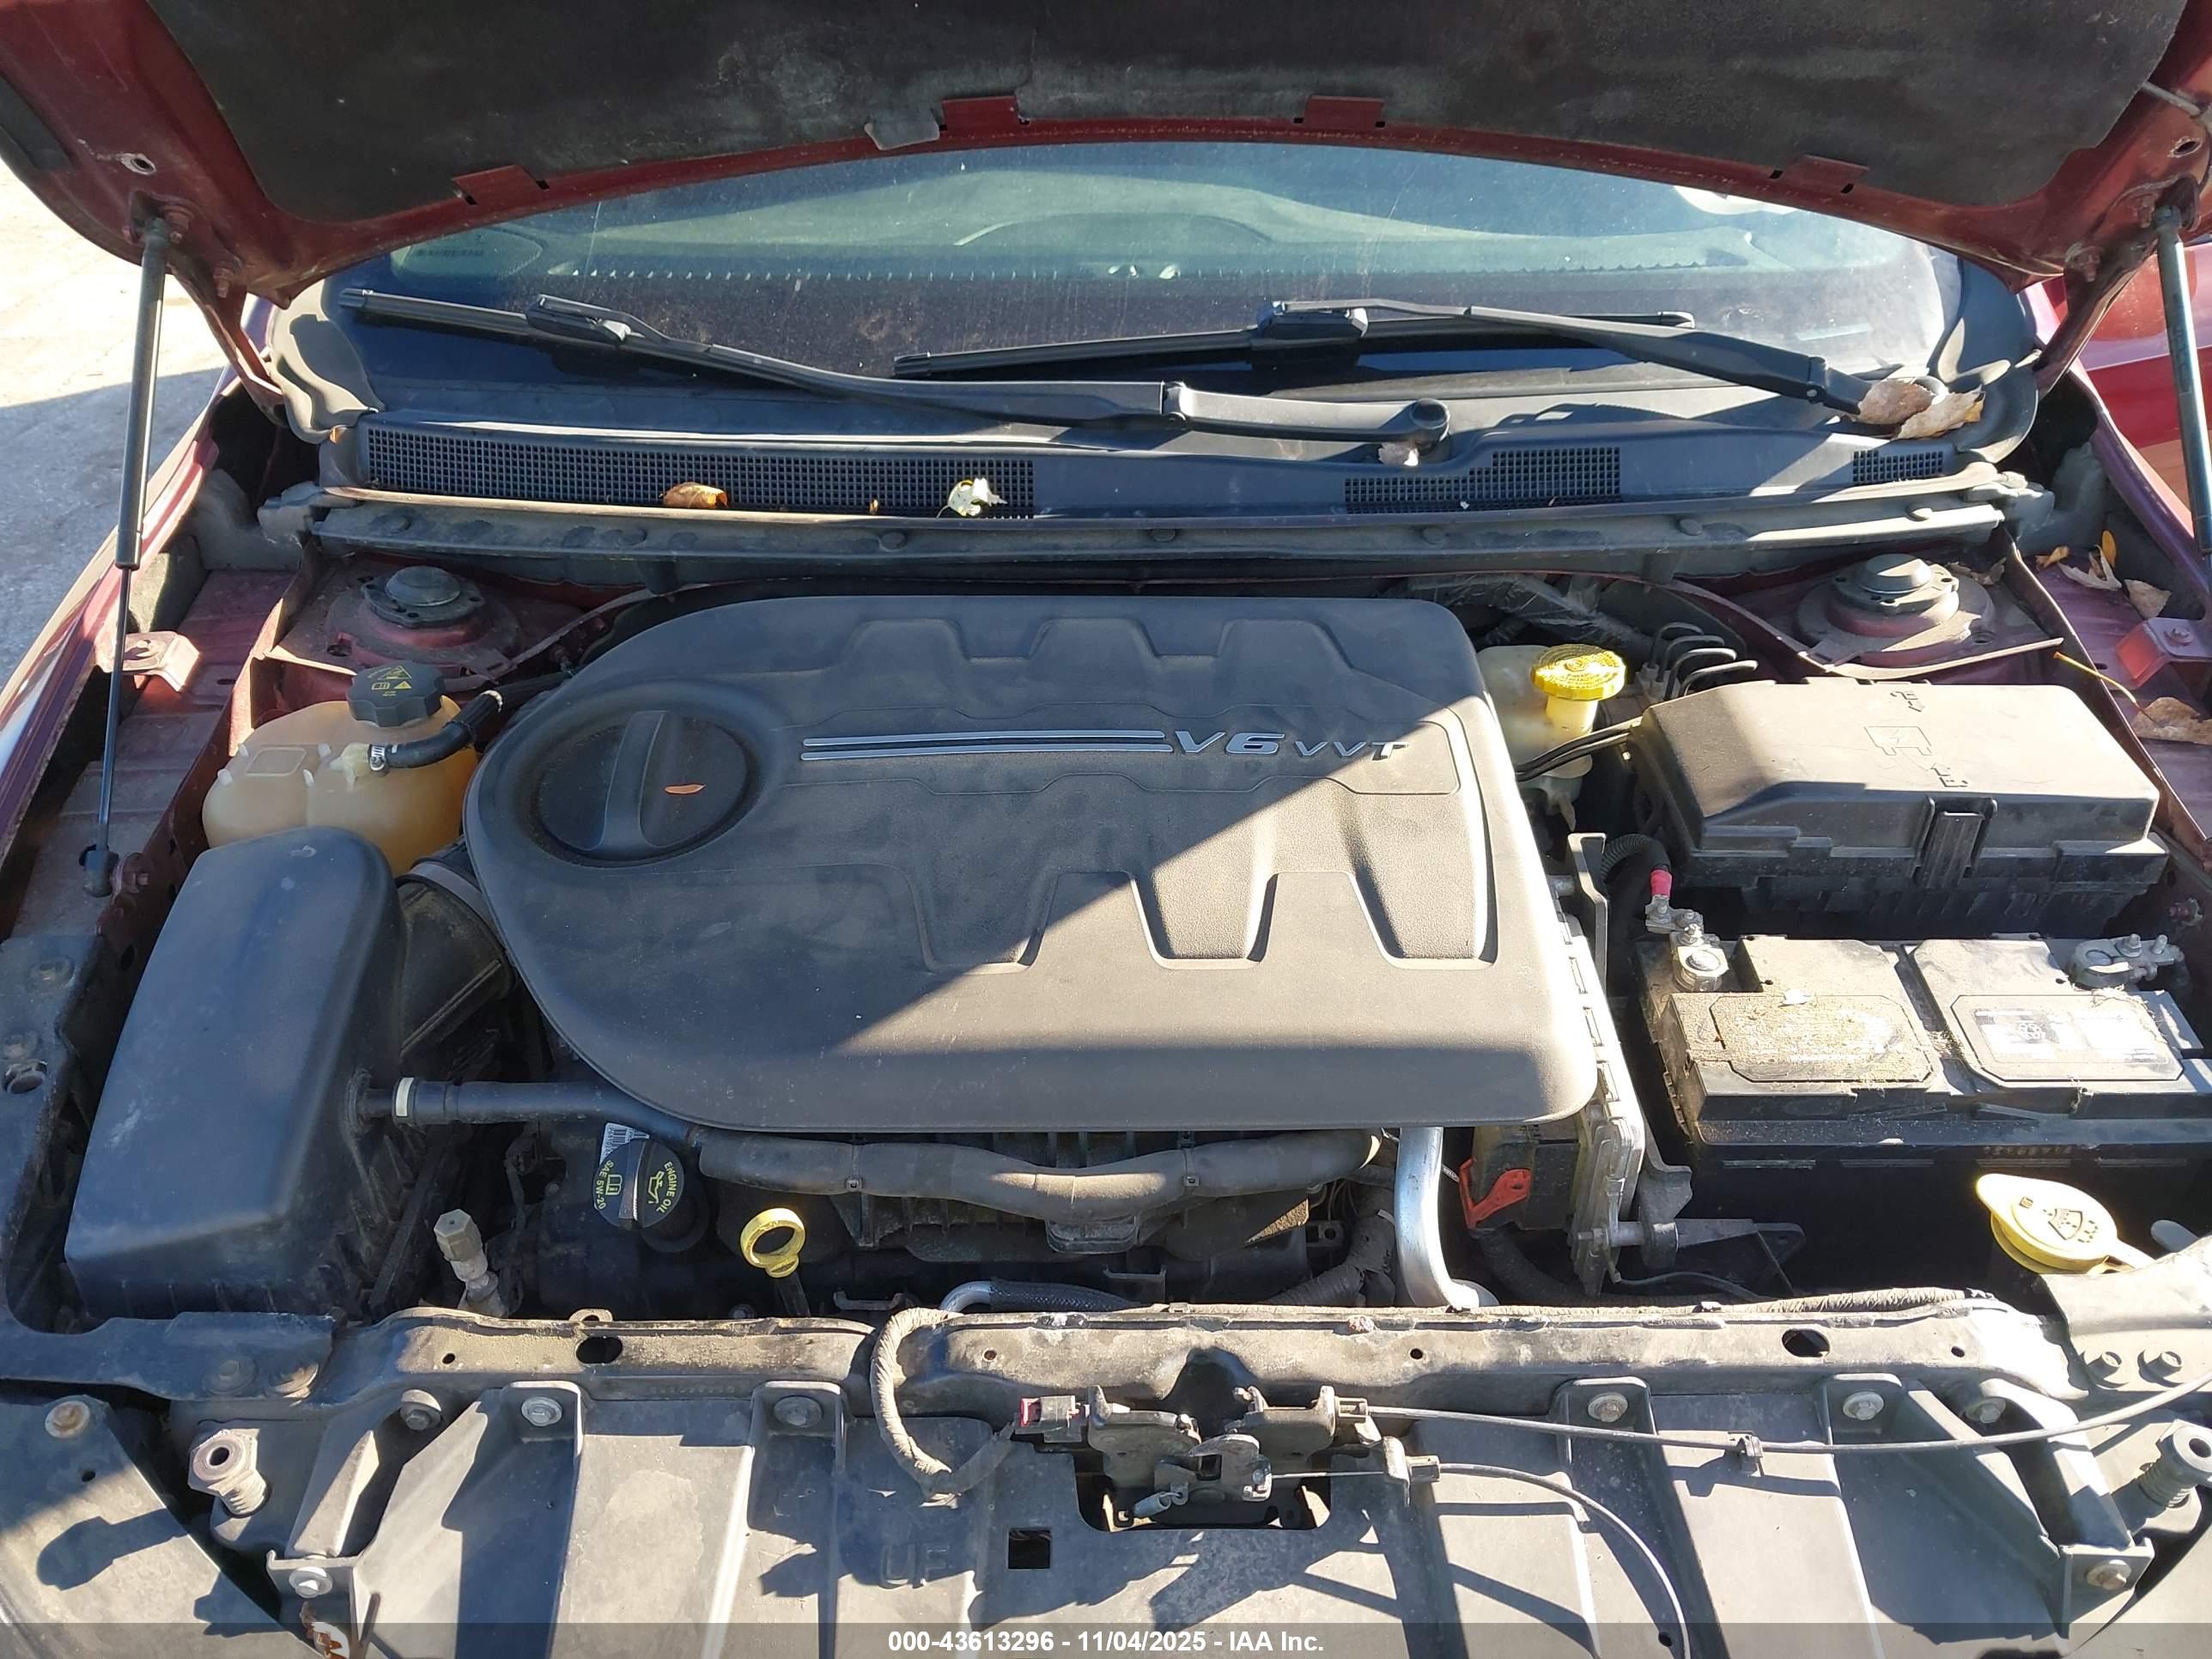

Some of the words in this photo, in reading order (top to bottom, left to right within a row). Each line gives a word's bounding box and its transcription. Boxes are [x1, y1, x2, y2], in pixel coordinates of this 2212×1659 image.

[1175, 731, 1285, 755] V6
[1294, 741, 1409, 761] VVT
[599, 1160, 614, 1178] SAE
[664, 1161, 678, 1198] ENGINE
[595, 1180, 606, 1210] 5W-20
[655, 1199, 672, 1213] OIL
